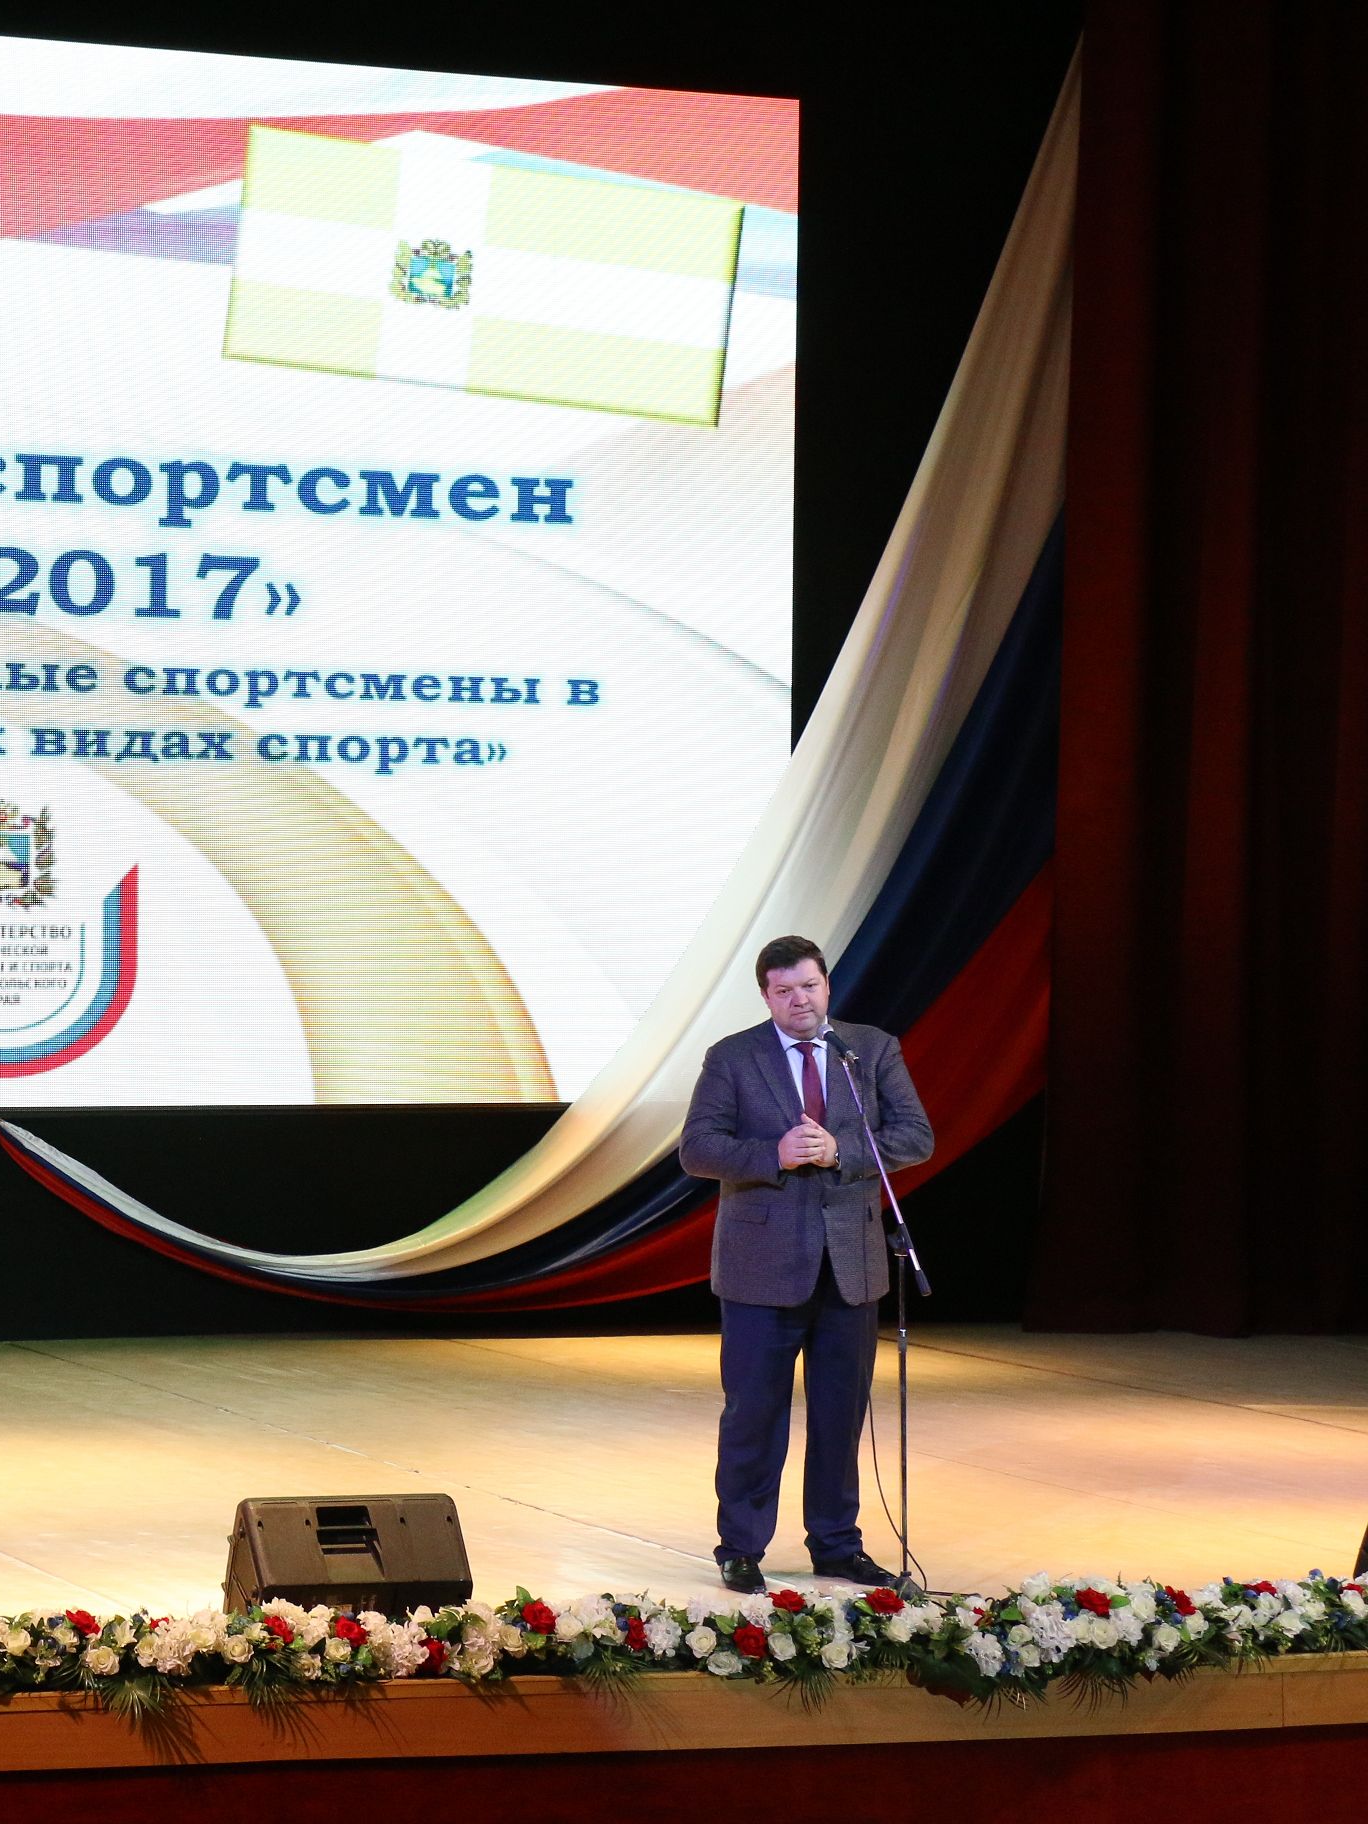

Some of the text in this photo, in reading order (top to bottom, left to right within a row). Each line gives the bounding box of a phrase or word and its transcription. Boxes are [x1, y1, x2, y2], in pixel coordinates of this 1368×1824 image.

[122, 664, 541, 709] спортсмены
[566, 677, 601, 707] в
[29, 726, 233, 764] видах
[256, 731, 508, 775] спорта»
